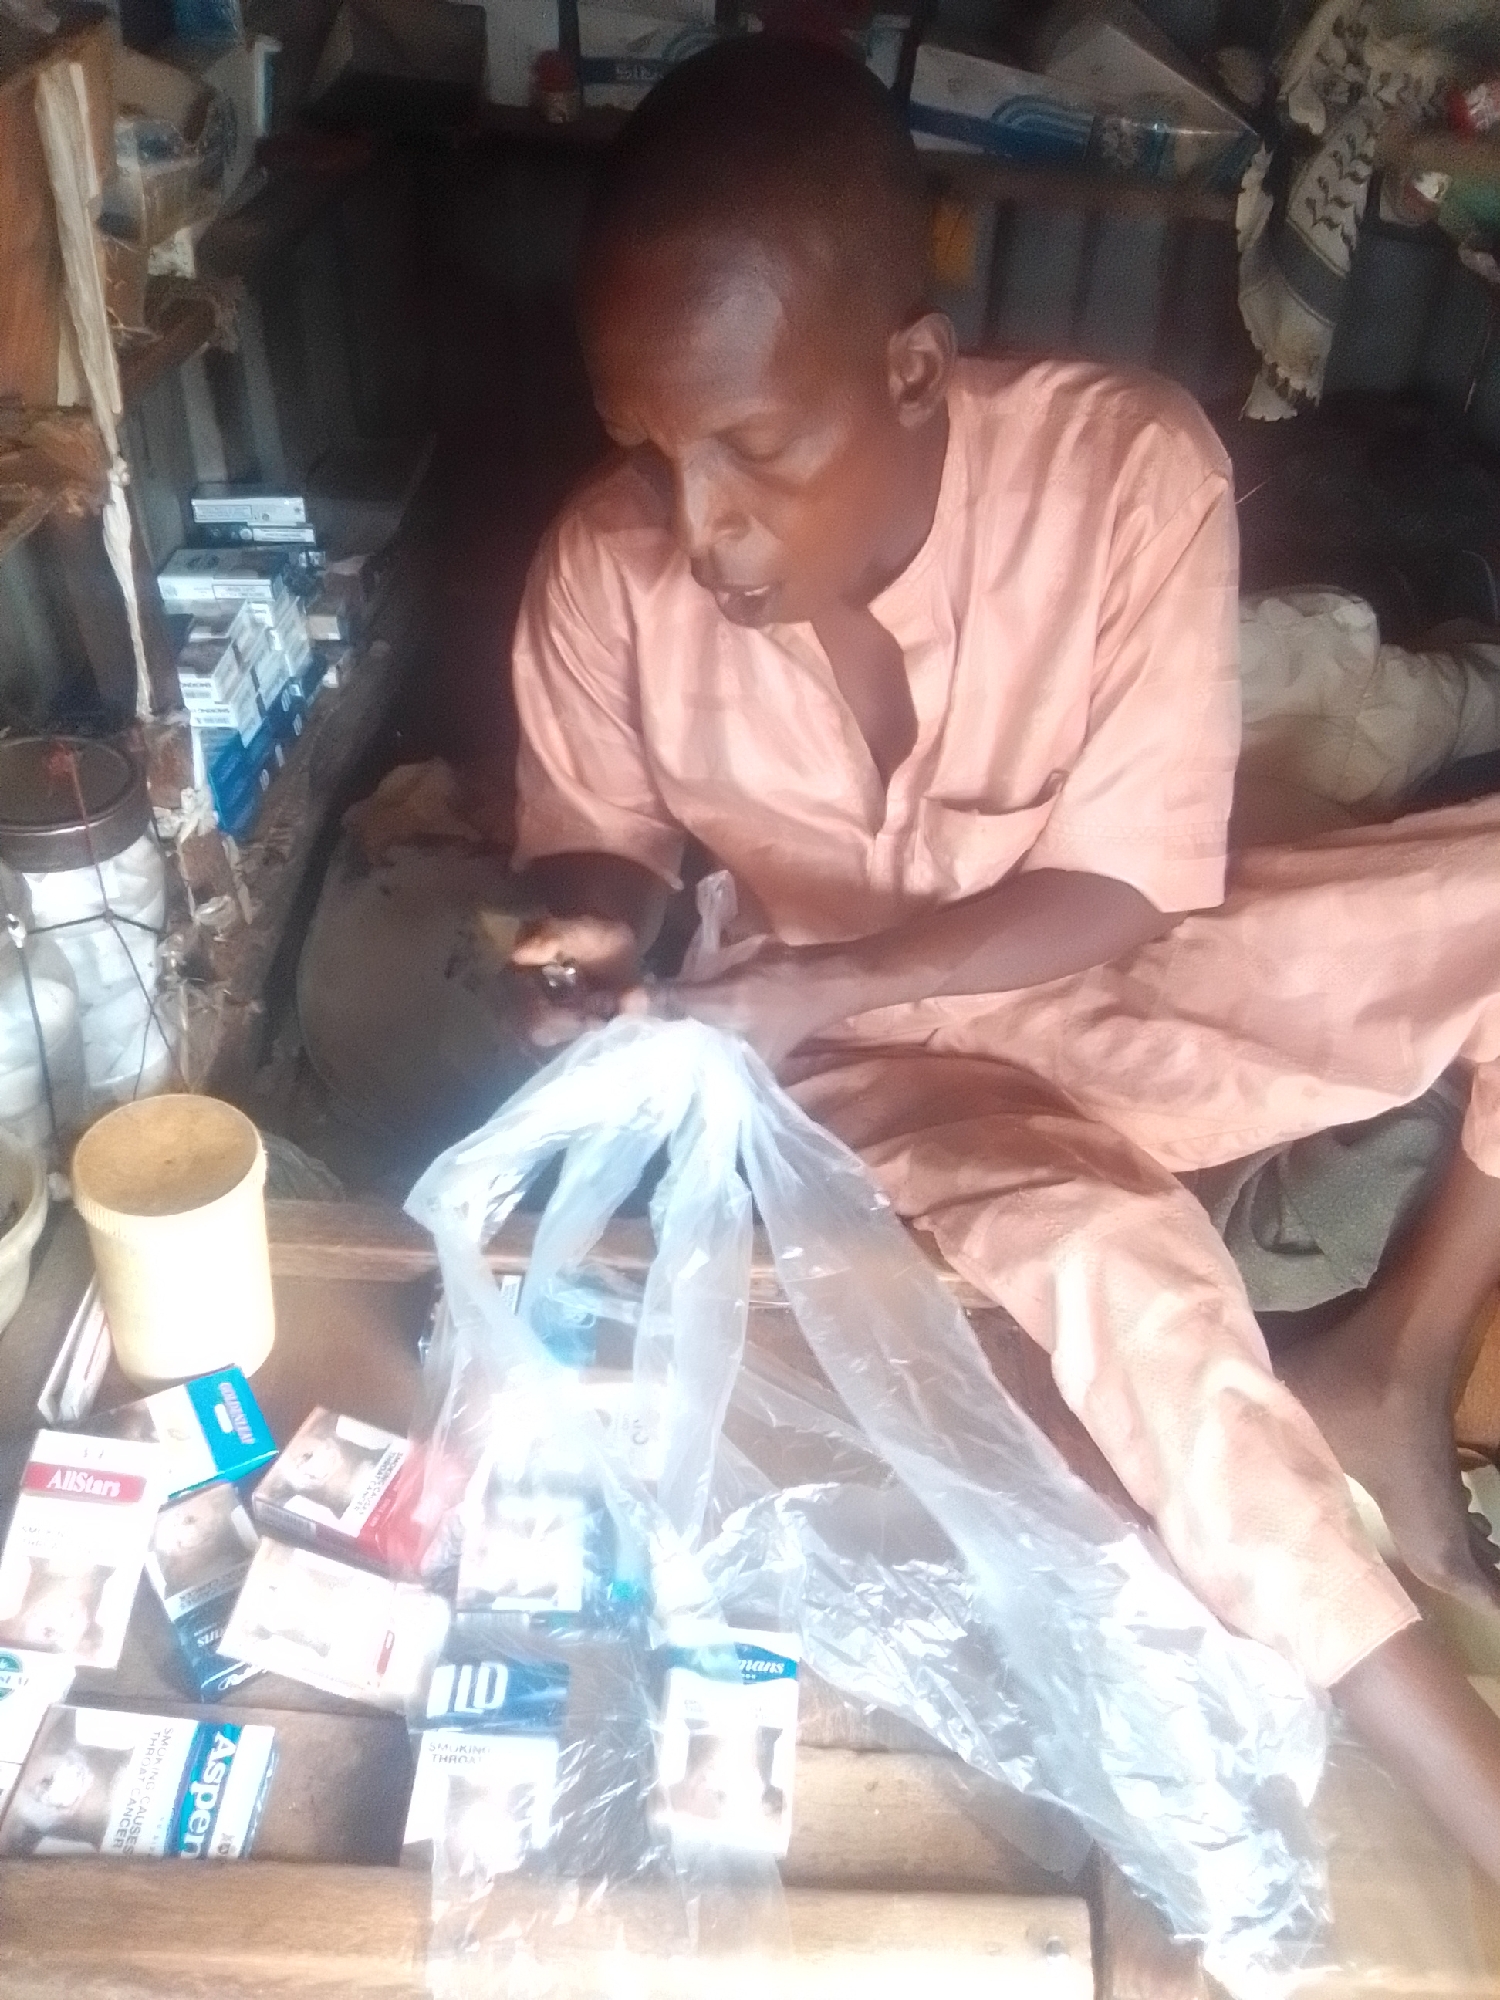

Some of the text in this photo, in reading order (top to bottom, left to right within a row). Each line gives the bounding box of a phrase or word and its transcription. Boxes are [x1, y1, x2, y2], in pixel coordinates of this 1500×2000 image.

[46, 1468, 121, 1498] AllStars
[113, 1731, 161, 1849] THROAT CANCER
[146, 1727, 173, 1790] SMOKING
[123, 1796, 150, 1855] CAUSES
[181, 1730, 237, 1859] Aspen
